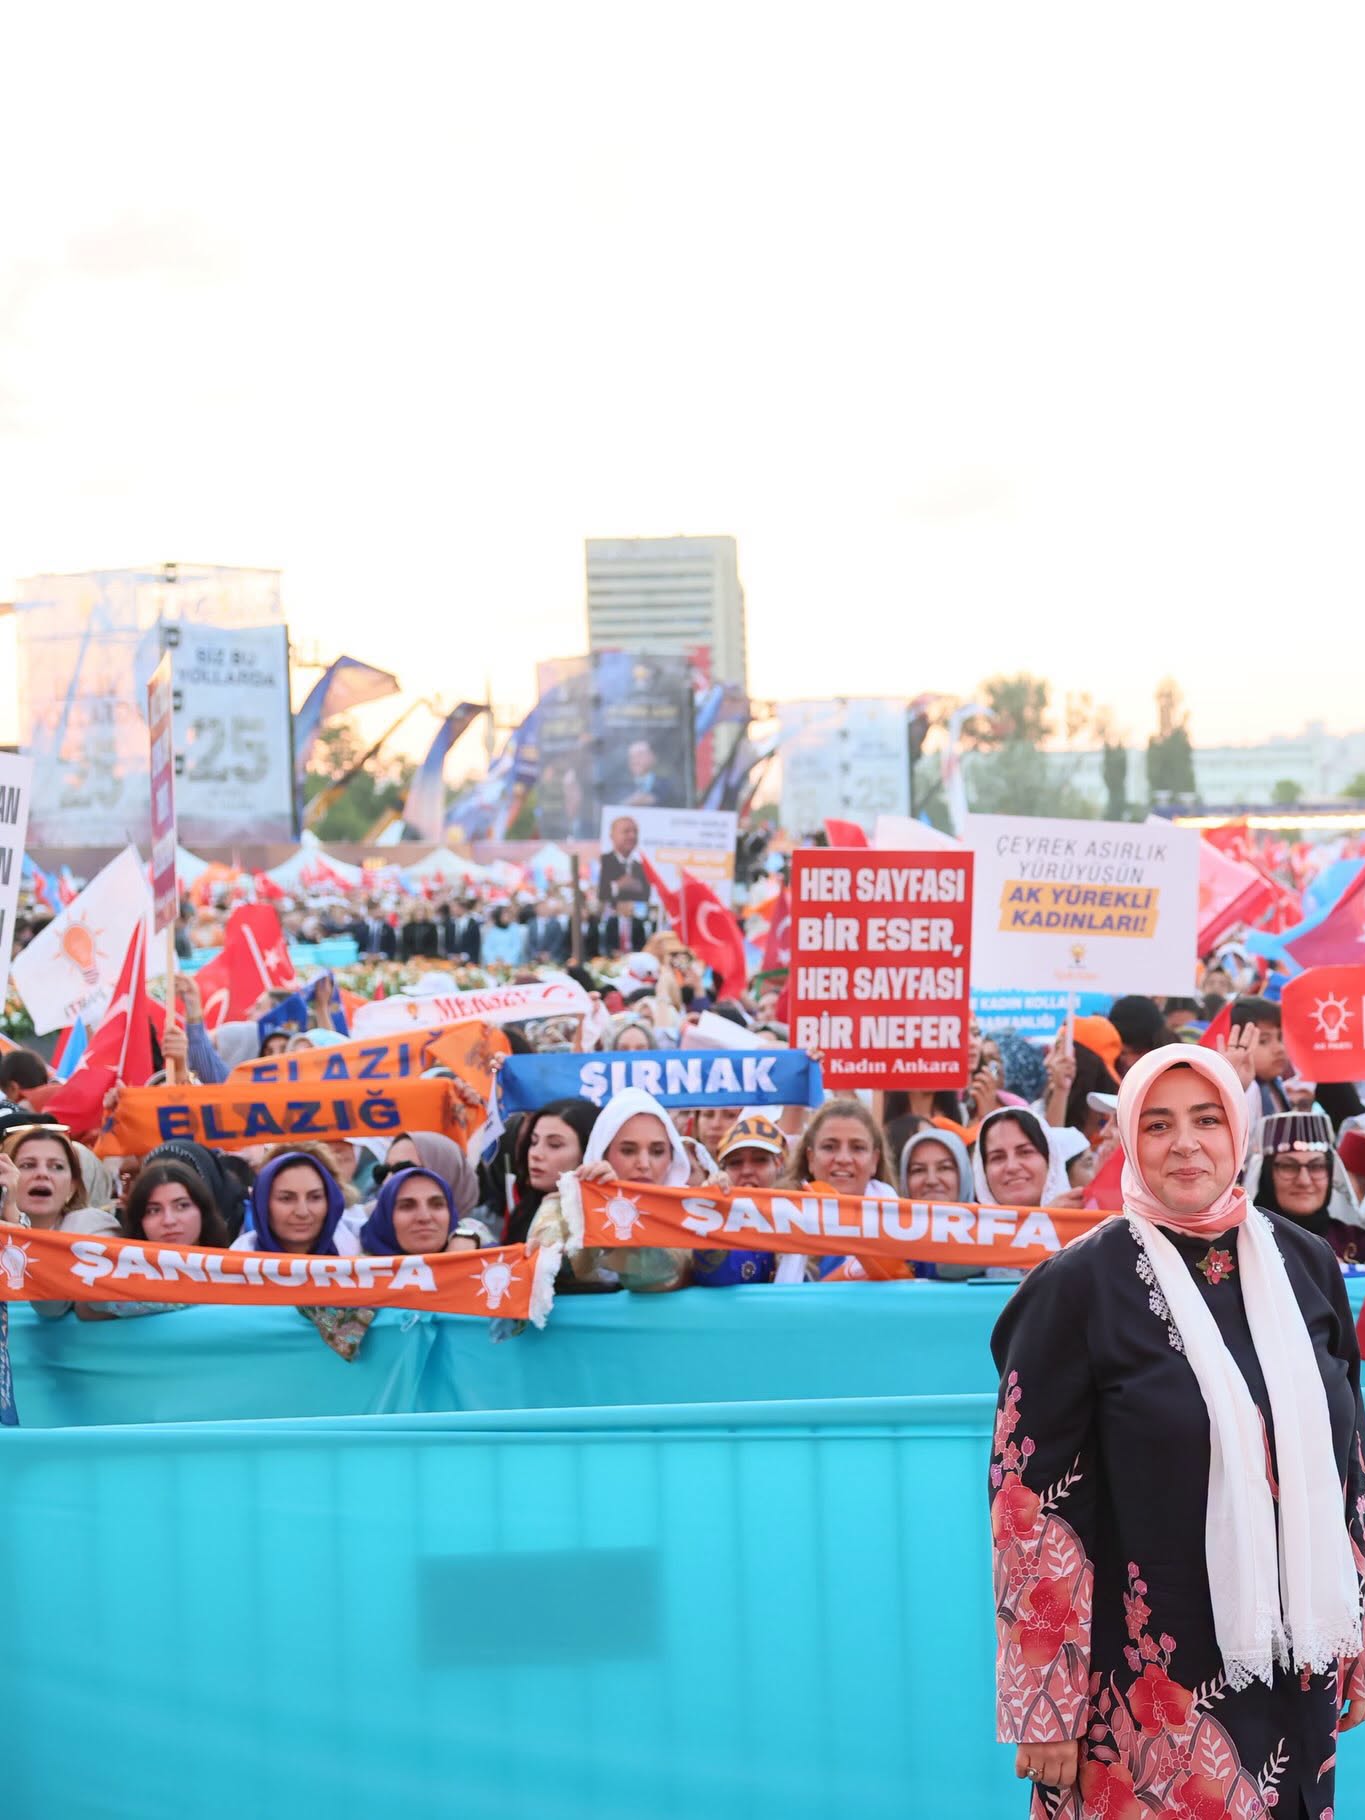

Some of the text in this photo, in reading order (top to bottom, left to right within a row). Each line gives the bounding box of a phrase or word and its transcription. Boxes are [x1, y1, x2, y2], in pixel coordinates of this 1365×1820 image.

[188, 716, 269, 784] 25
[996, 835, 1168, 862] ÇEYREK ASIRLIK
[801, 868, 966, 902] HER SAYFASI
[1018, 860, 1145, 885] YÜRÜYÜŞÜN
[1008, 885, 1154, 910] AK YÜREKLİ
[798, 912, 964, 958] BİR ESER,
[1011, 909, 1149, 933] KADINLARI!
[797, 967, 964, 1000] HER SAYFASI
[796, 1010, 961, 1049] BİR NEFER
[579, 1056, 778, 1107] ŞIRNAK
[830, 1059, 887, 1074] Kadın
[892, 1059, 960, 1074] Ankara
[157, 1090, 401, 1142] ELAZIĞ
[680, 1196, 1062, 1251] ŞANLIURFA
[70, 1240, 437, 1292] ŞANLIURFA
